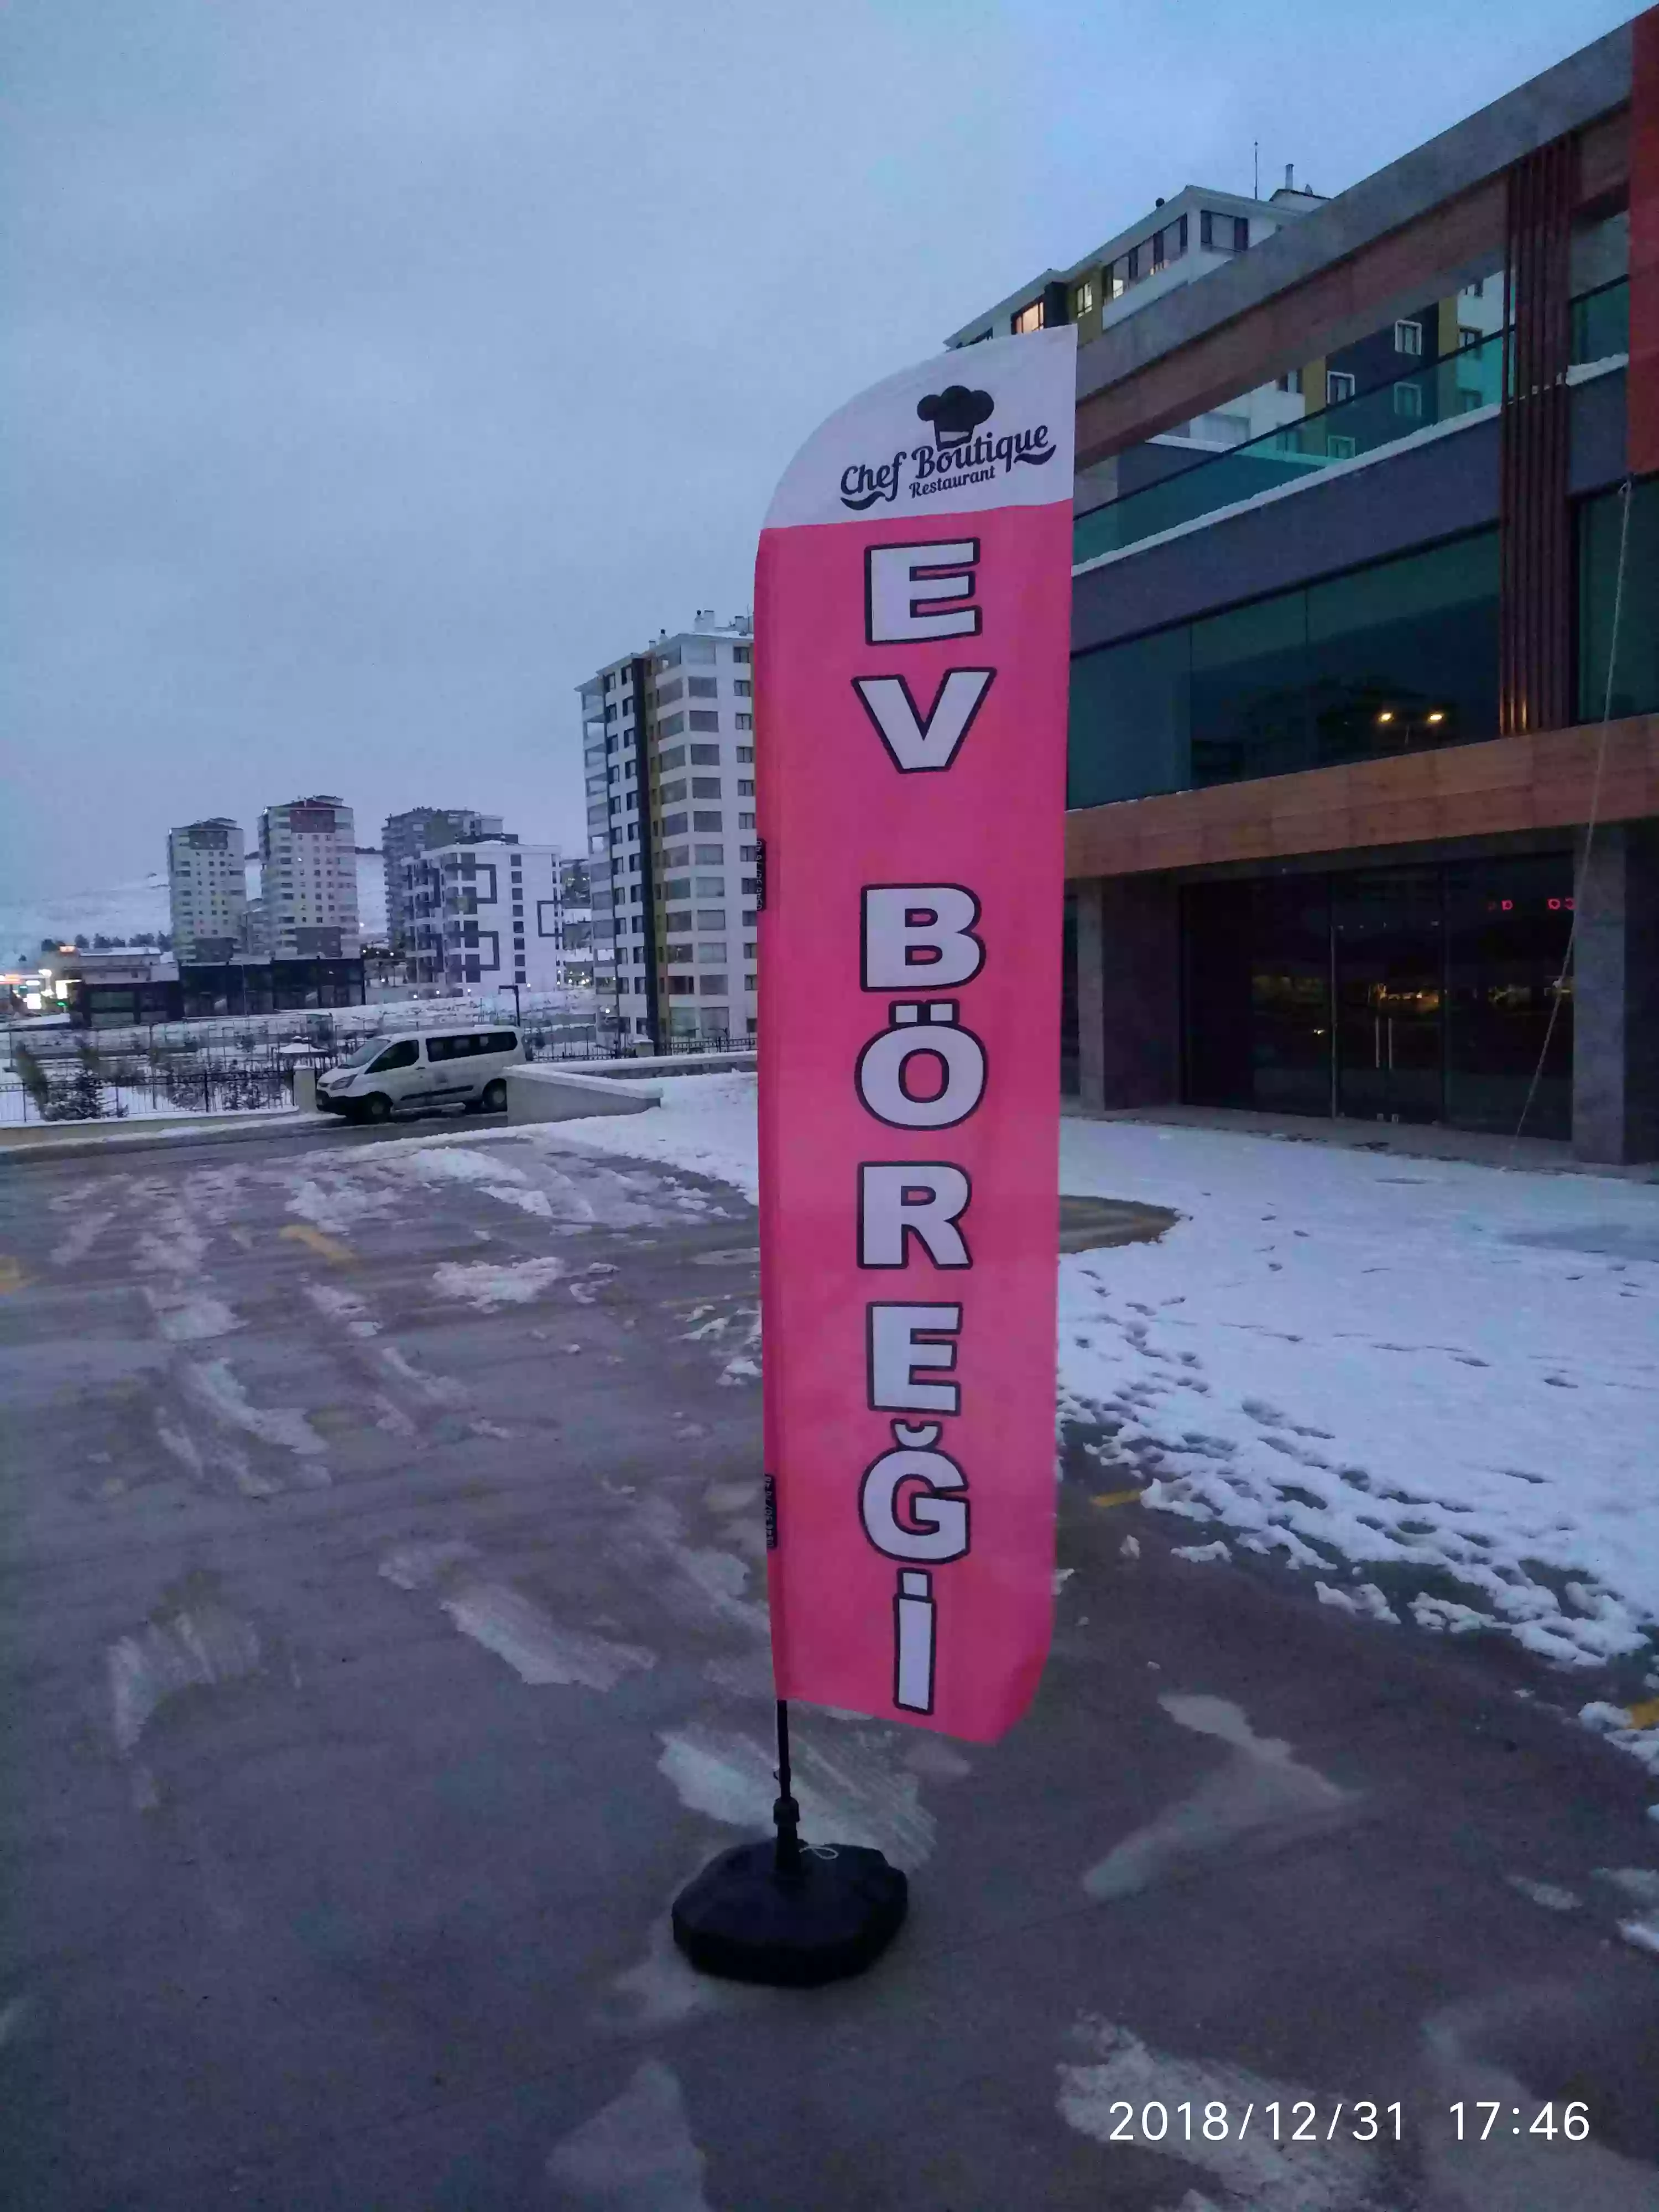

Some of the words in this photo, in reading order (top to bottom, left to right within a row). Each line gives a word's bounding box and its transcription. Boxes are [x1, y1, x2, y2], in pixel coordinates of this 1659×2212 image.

[840, 451, 907, 510] Chef
[911, 424, 1057, 479] Boutique
[909, 465, 996, 498] Restaurant
[851, 538, 997, 774] EV
